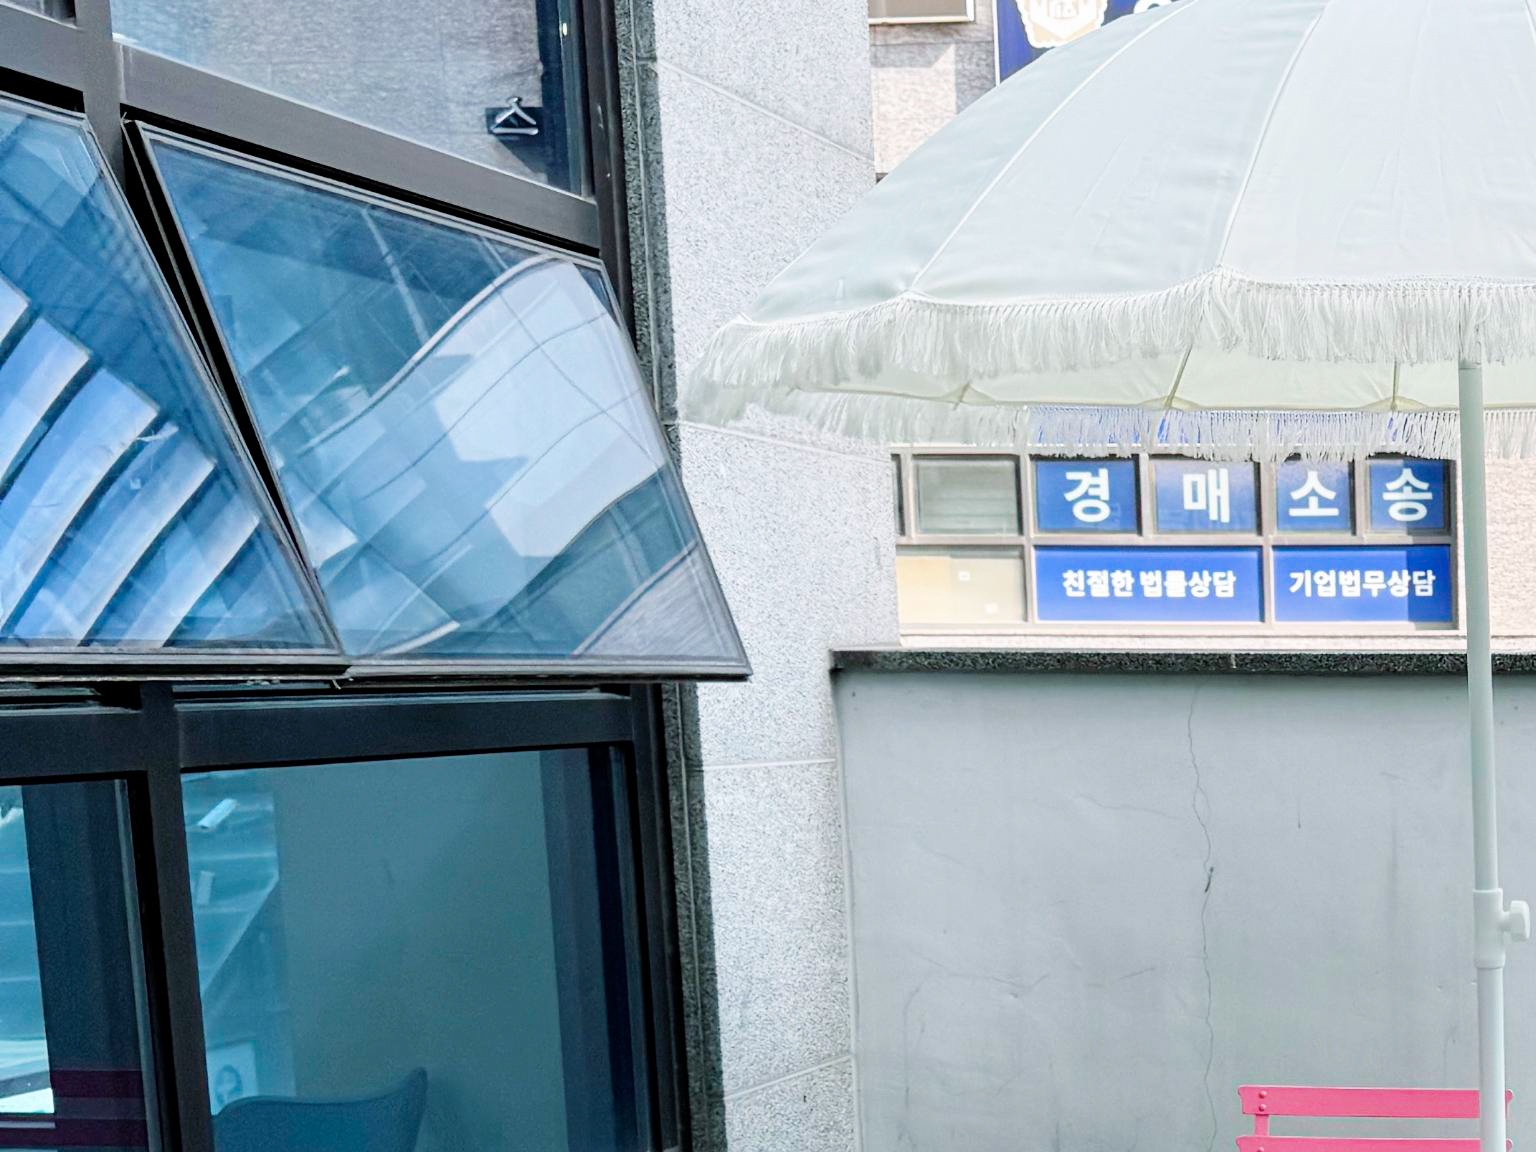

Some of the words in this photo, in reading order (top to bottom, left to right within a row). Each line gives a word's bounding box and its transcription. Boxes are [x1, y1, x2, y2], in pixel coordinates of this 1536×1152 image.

[1062, 569, 1135, 598] 친절한
[1139, 569, 1237, 598] 법률상담
[1288, 569, 1436, 598] 기업법무상담
